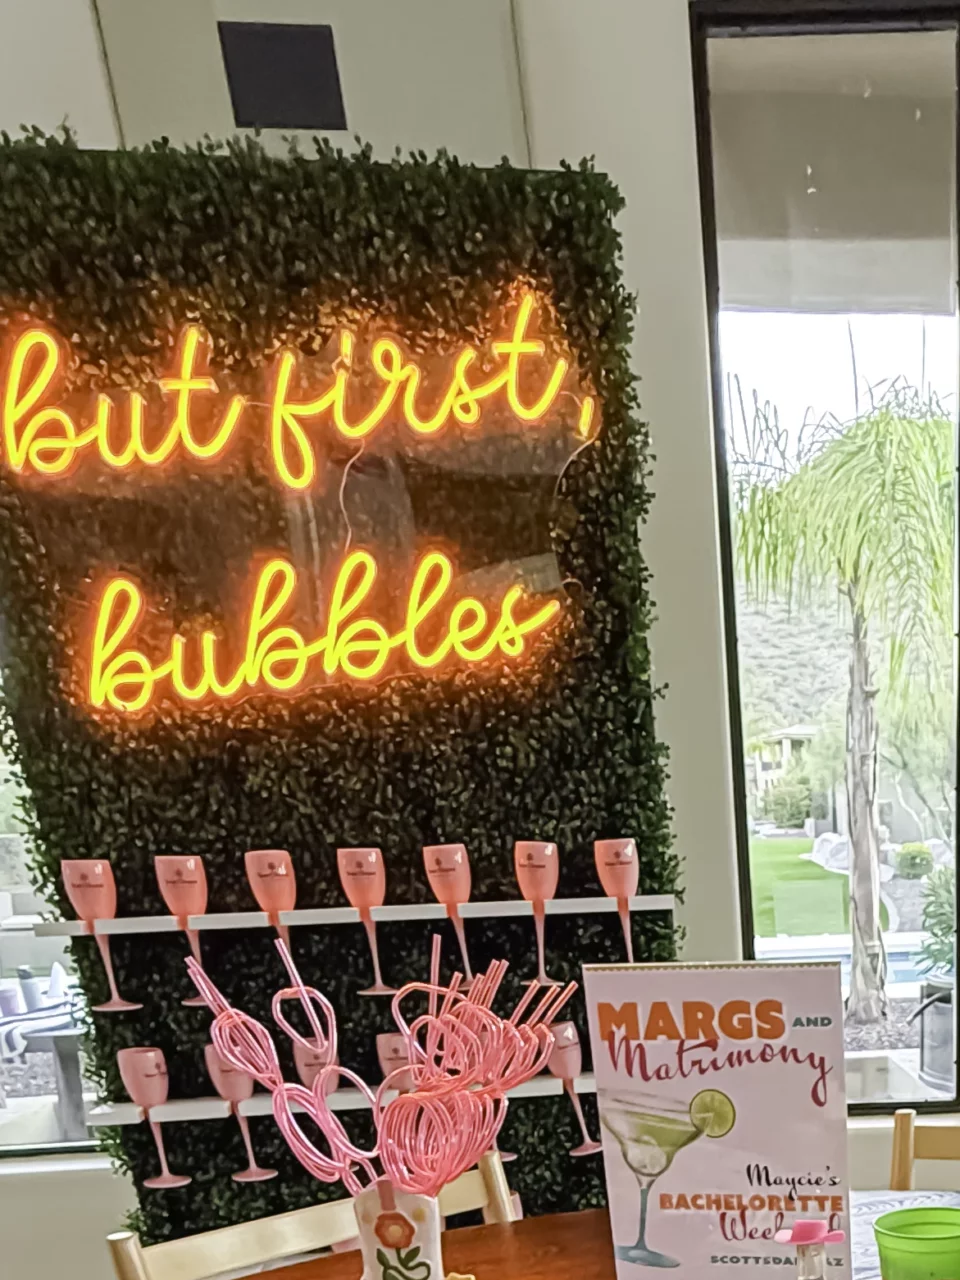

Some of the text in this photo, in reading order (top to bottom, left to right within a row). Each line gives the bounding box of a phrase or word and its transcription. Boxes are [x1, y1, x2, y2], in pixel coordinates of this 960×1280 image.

[3, 294, 596, 489] but first,
[90, 550, 561, 711] bubbles
[597, 999, 833, 1042] MARGS AND
[606, 1030, 834, 1108] Matrimony
[659, 1193, 844, 1213] BACHELORETTE
[746, 1163, 841, 1201] Maycie's
